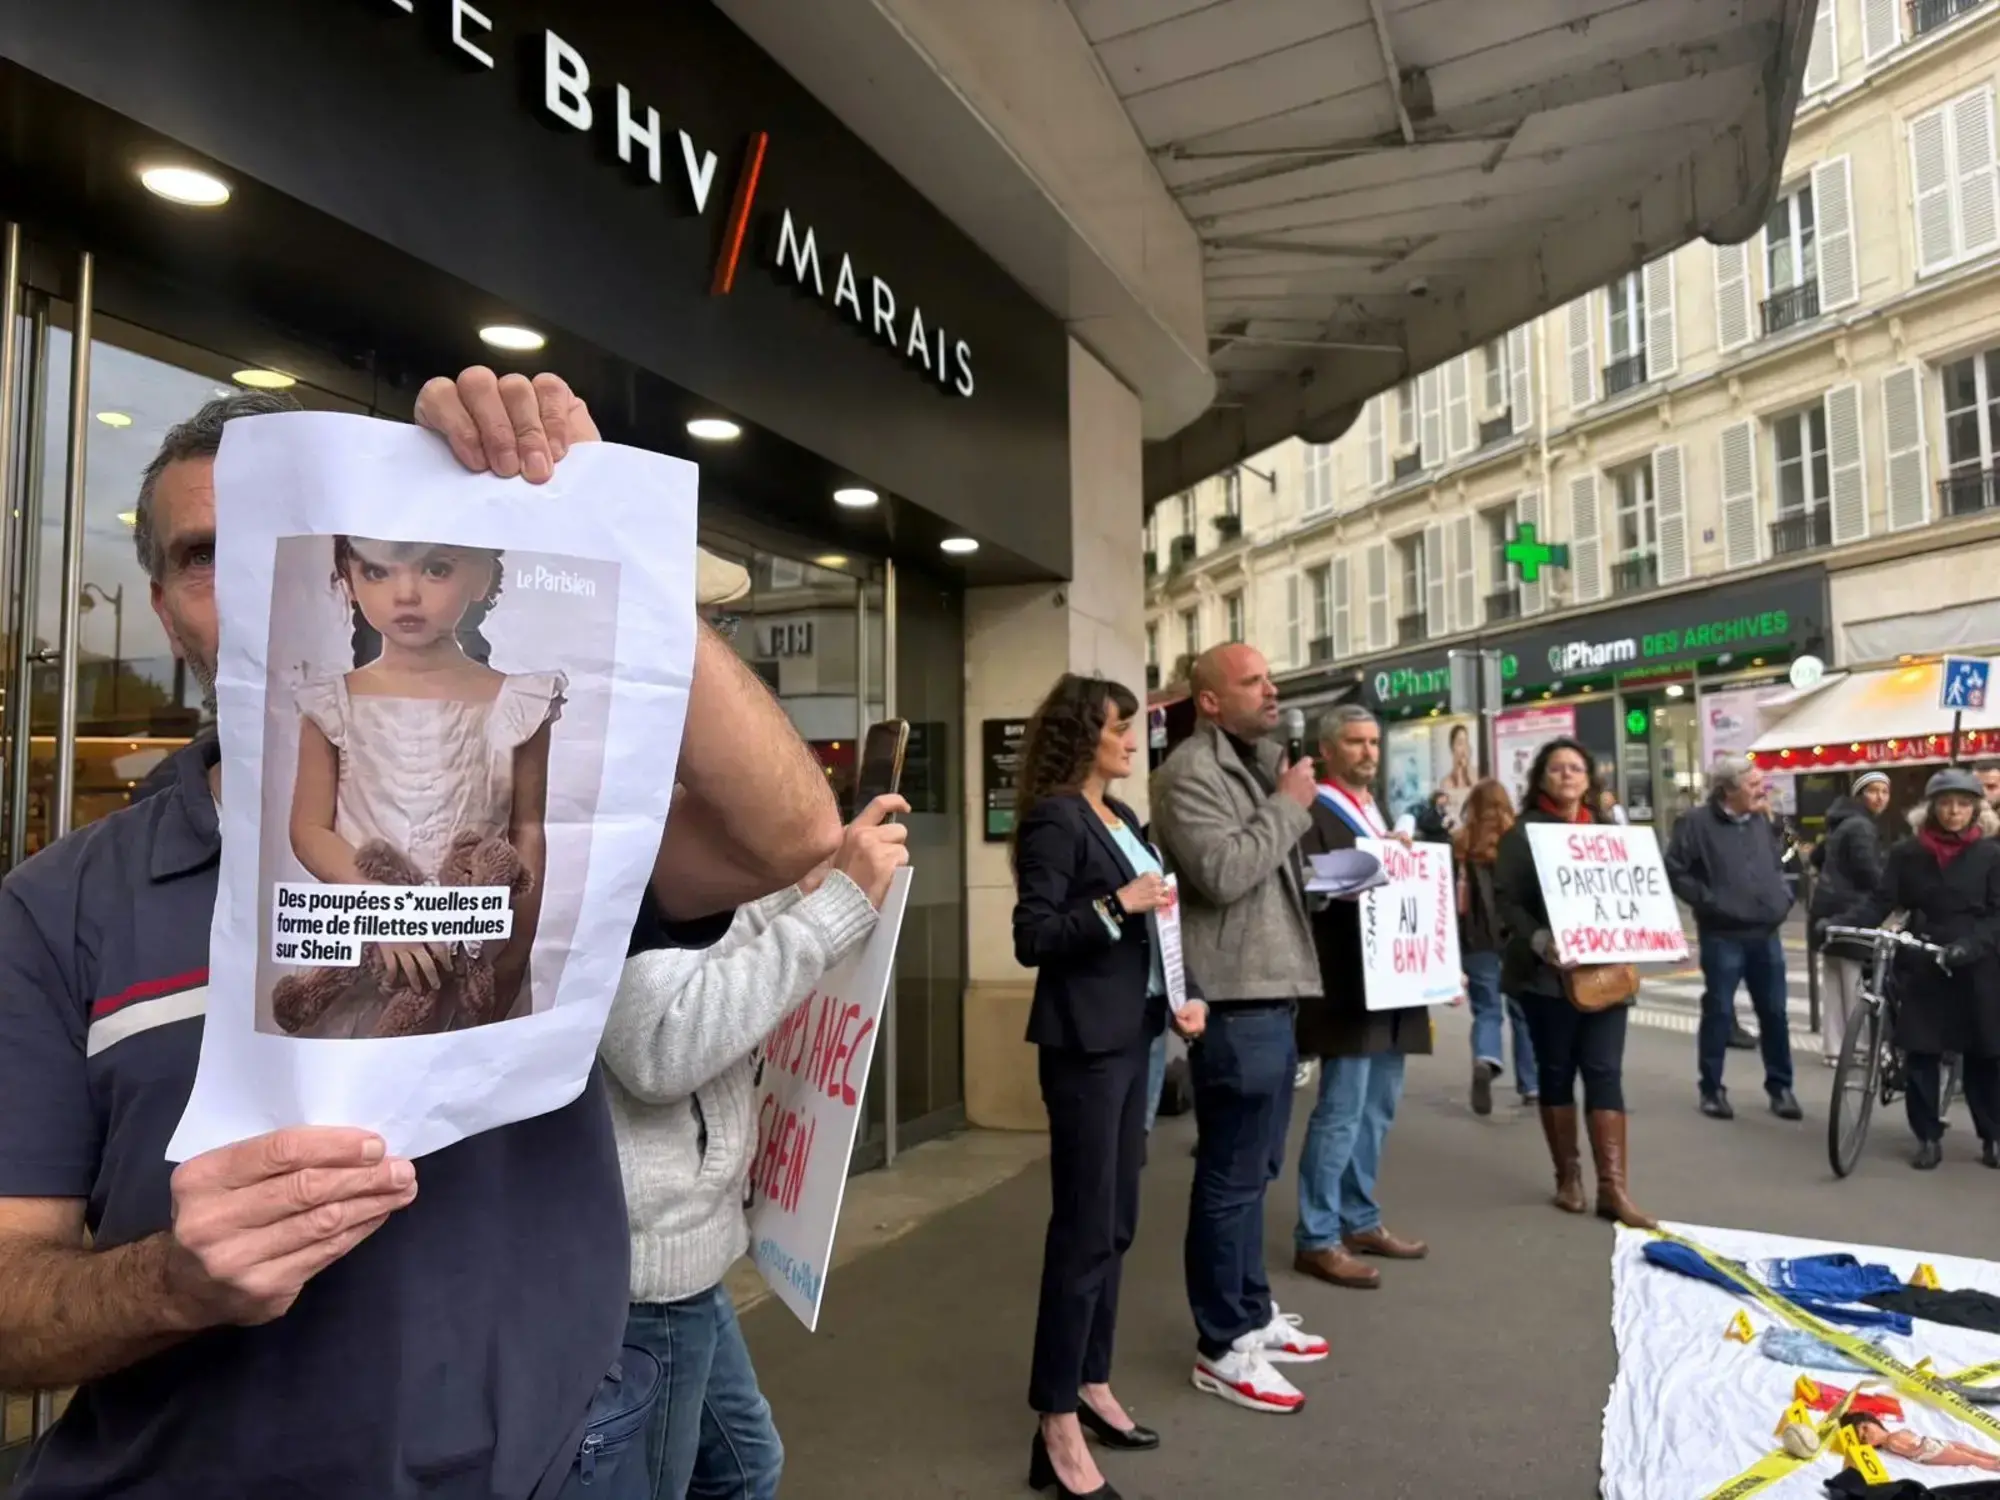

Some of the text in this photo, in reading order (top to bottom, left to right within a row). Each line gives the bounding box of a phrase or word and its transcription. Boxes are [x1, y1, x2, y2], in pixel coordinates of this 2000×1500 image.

[545, 29, 716, 215] BHV
[776, 208, 974, 398] MARAIS
[516, 563, 596, 597] Le Parisien
[1642, 628, 1679, 658] DES
[1683, 610, 1789, 649] ARCHIVES
[1556, 865, 1661, 897] PARTICIPE
[278, 889, 306, 911] Des
[309, 888, 391, 914] poupées
[481, 895, 503, 911] en
[1399, 896, 1418, 935] AU
[1617, 900, 1640, 920] LA
[277, 913, 505, 936] forme de fillettes vendues
[276, 940, 352, 961] sur Shein
[1393, 934, 1428, 974] BHV
[805, 995, 873, 1106] AVEC
